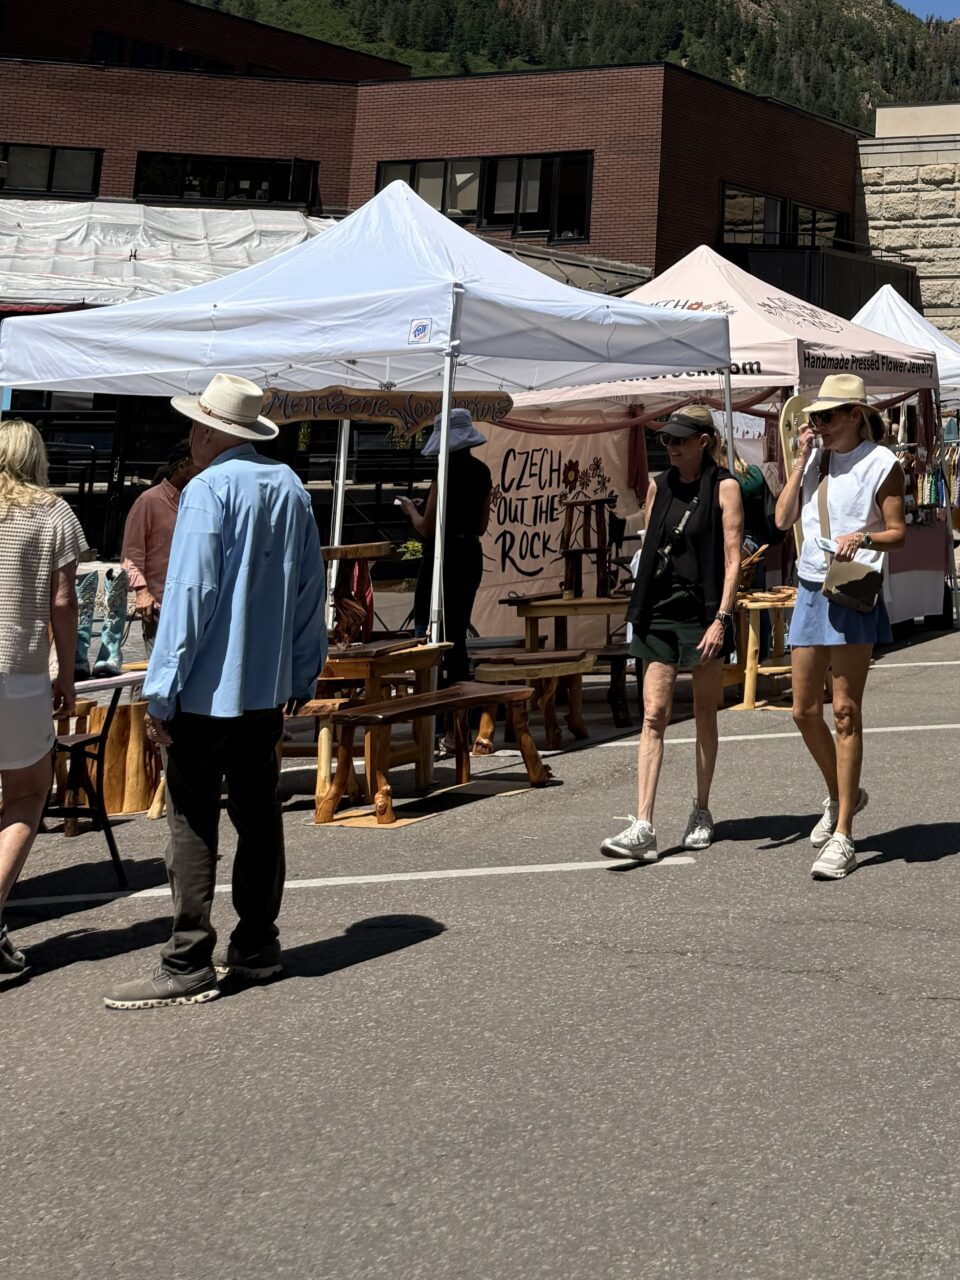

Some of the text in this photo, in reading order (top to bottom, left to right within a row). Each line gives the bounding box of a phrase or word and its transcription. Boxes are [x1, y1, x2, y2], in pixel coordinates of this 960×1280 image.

[803, 351, 934, 379] Handmade Pressed Flower Jewelry
[501, 448, 562, 493] CZECH
[497, 495, 560, 527] OUT THE
[495, 529, 557, 577] ROCK
